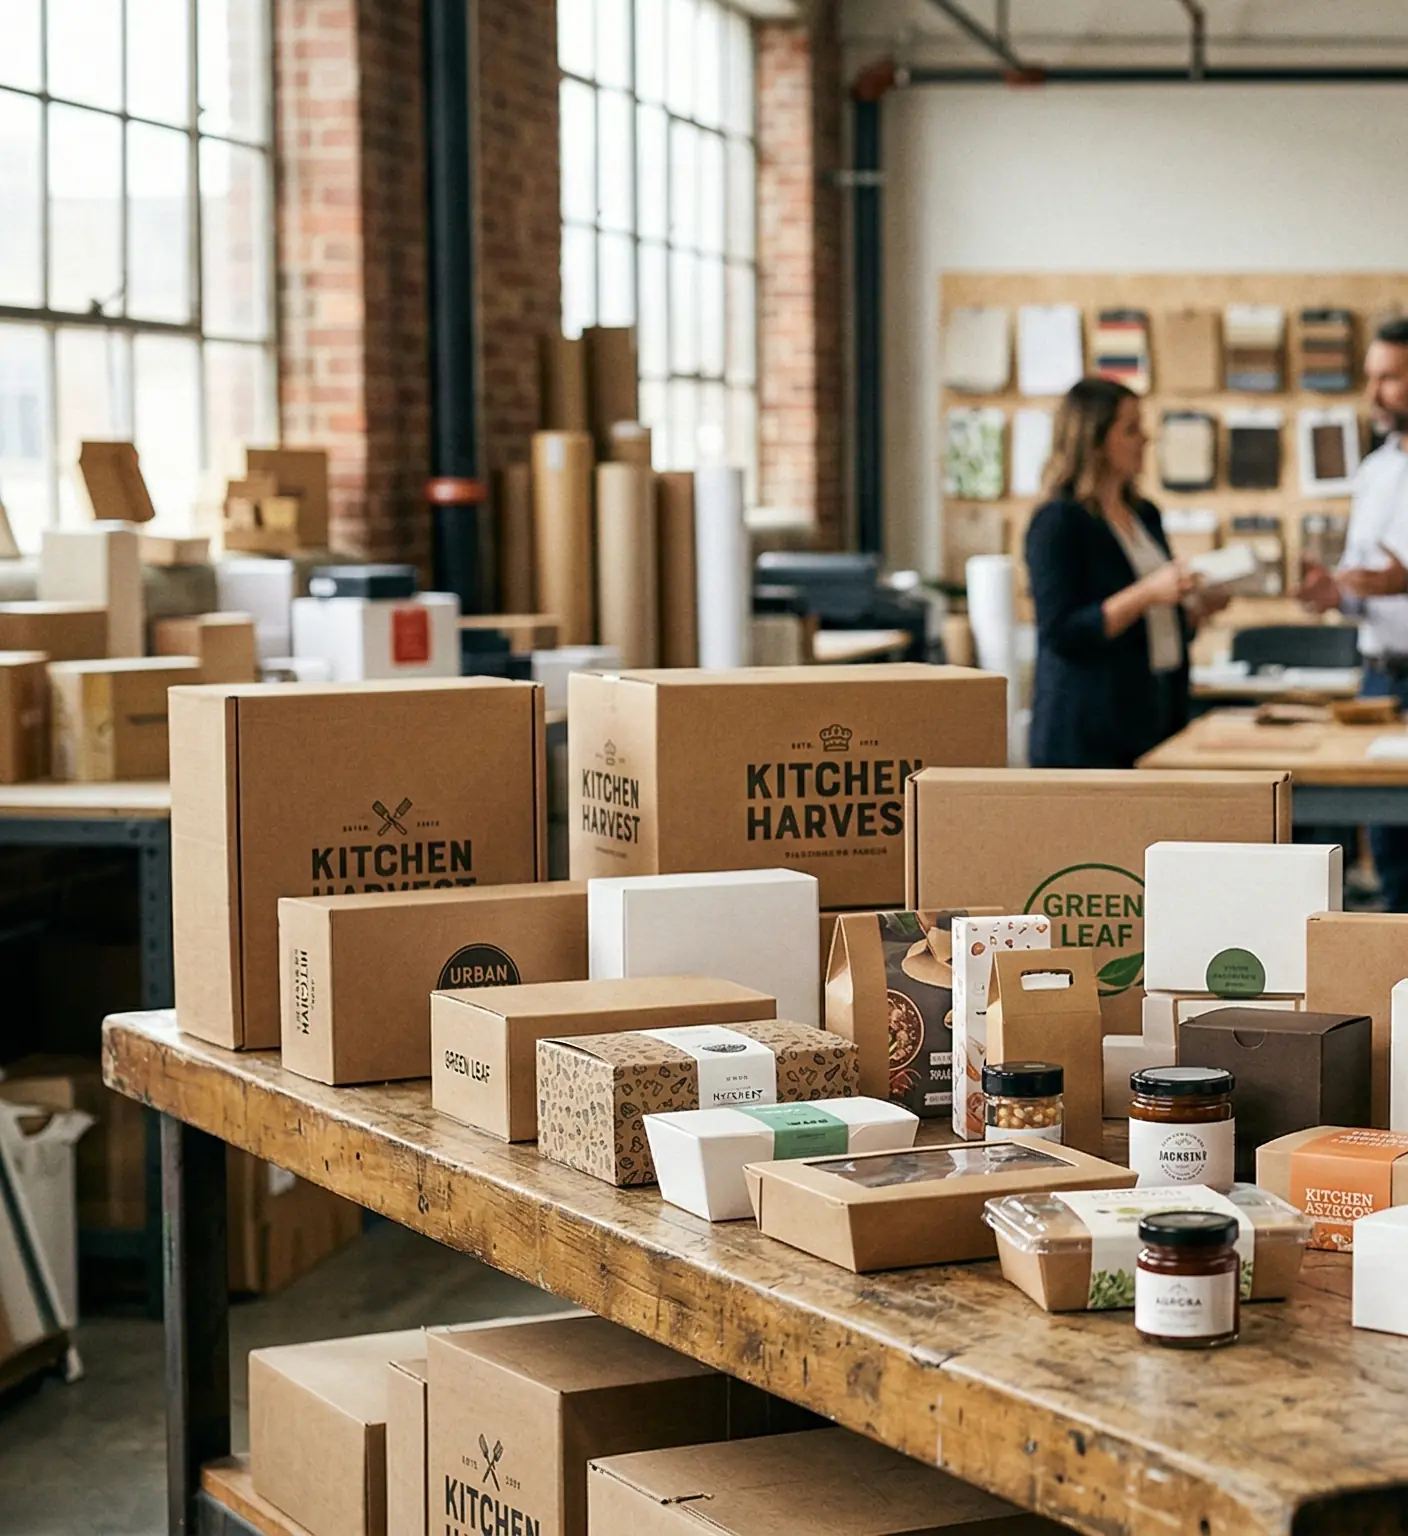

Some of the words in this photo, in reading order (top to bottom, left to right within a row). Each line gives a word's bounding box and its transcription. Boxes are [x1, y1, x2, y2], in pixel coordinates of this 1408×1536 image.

[582, 768, 639, 810] KITCHEN
[582, 805, 641, 844] HARVEST
[747, 801, 905, 841] HARVES
[311, 839, 473, 881] KITCHEN
[1043, 893, 1143, 918] GREEN
[1061, 923, 1133, 948] LEAF
[450, 964, 508, 984] URBAN
[1304, 1187, 1374, 1207] KITCHEN
